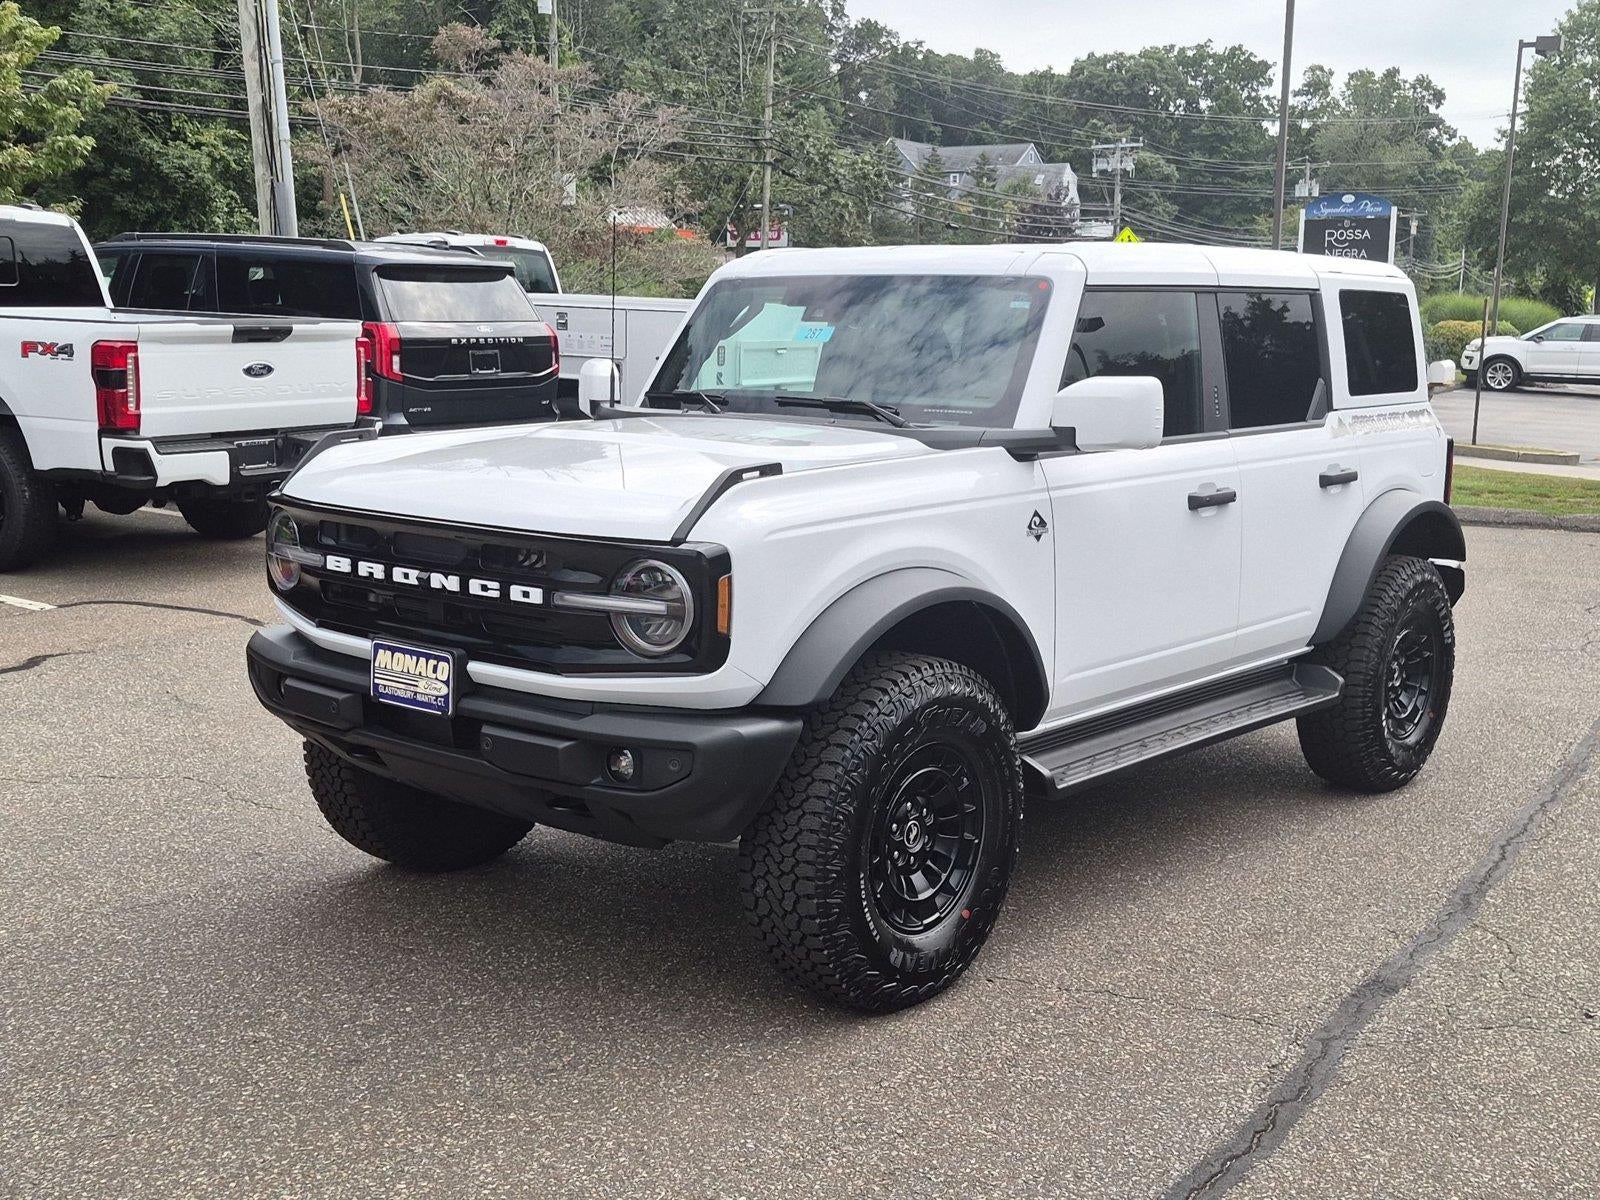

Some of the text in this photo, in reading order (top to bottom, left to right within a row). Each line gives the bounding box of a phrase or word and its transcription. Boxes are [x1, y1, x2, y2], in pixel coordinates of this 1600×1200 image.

[1314, 200, 1382, 216] Signature Plaza
[1324, 229, 1371, 248] ROSSA
[451, 337, 524, 345] EXPEDITION
[804, 328, 823, 339] 287
[21, 341, 74, 358] FX4
[156, 382, 348, 400] SUPER DUTY
[326, 555, 543, 605] BRONCO
[375, 649, 449, 682] MONACO
[424, 680, 442, 694] Ford
